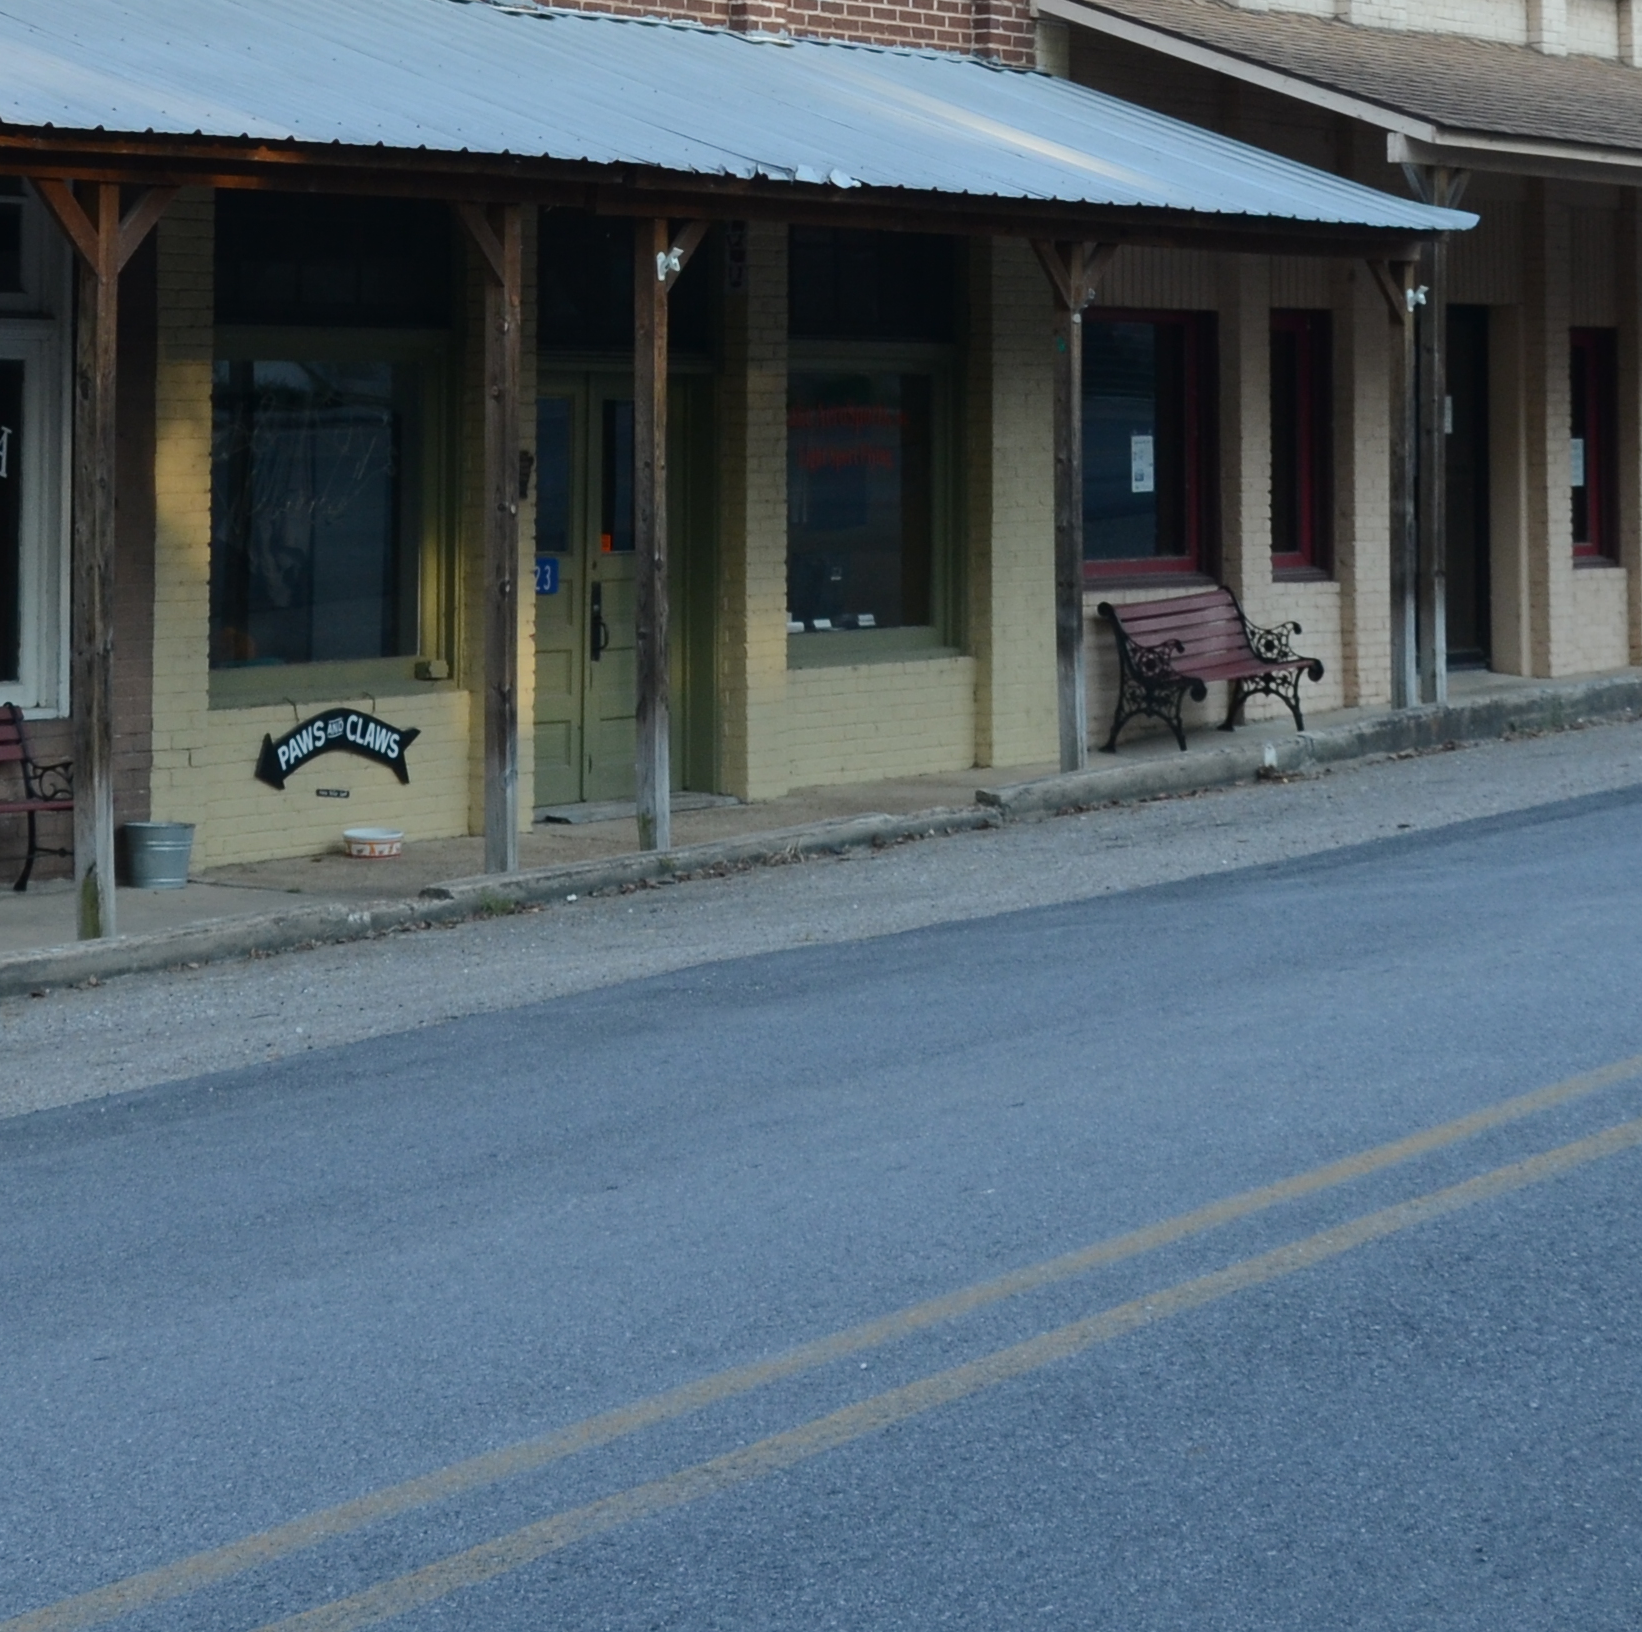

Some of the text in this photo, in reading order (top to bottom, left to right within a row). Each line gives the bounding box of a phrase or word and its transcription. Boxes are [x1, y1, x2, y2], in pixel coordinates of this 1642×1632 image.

[278, 714, 400, 771] PAWS AND CLAWS
